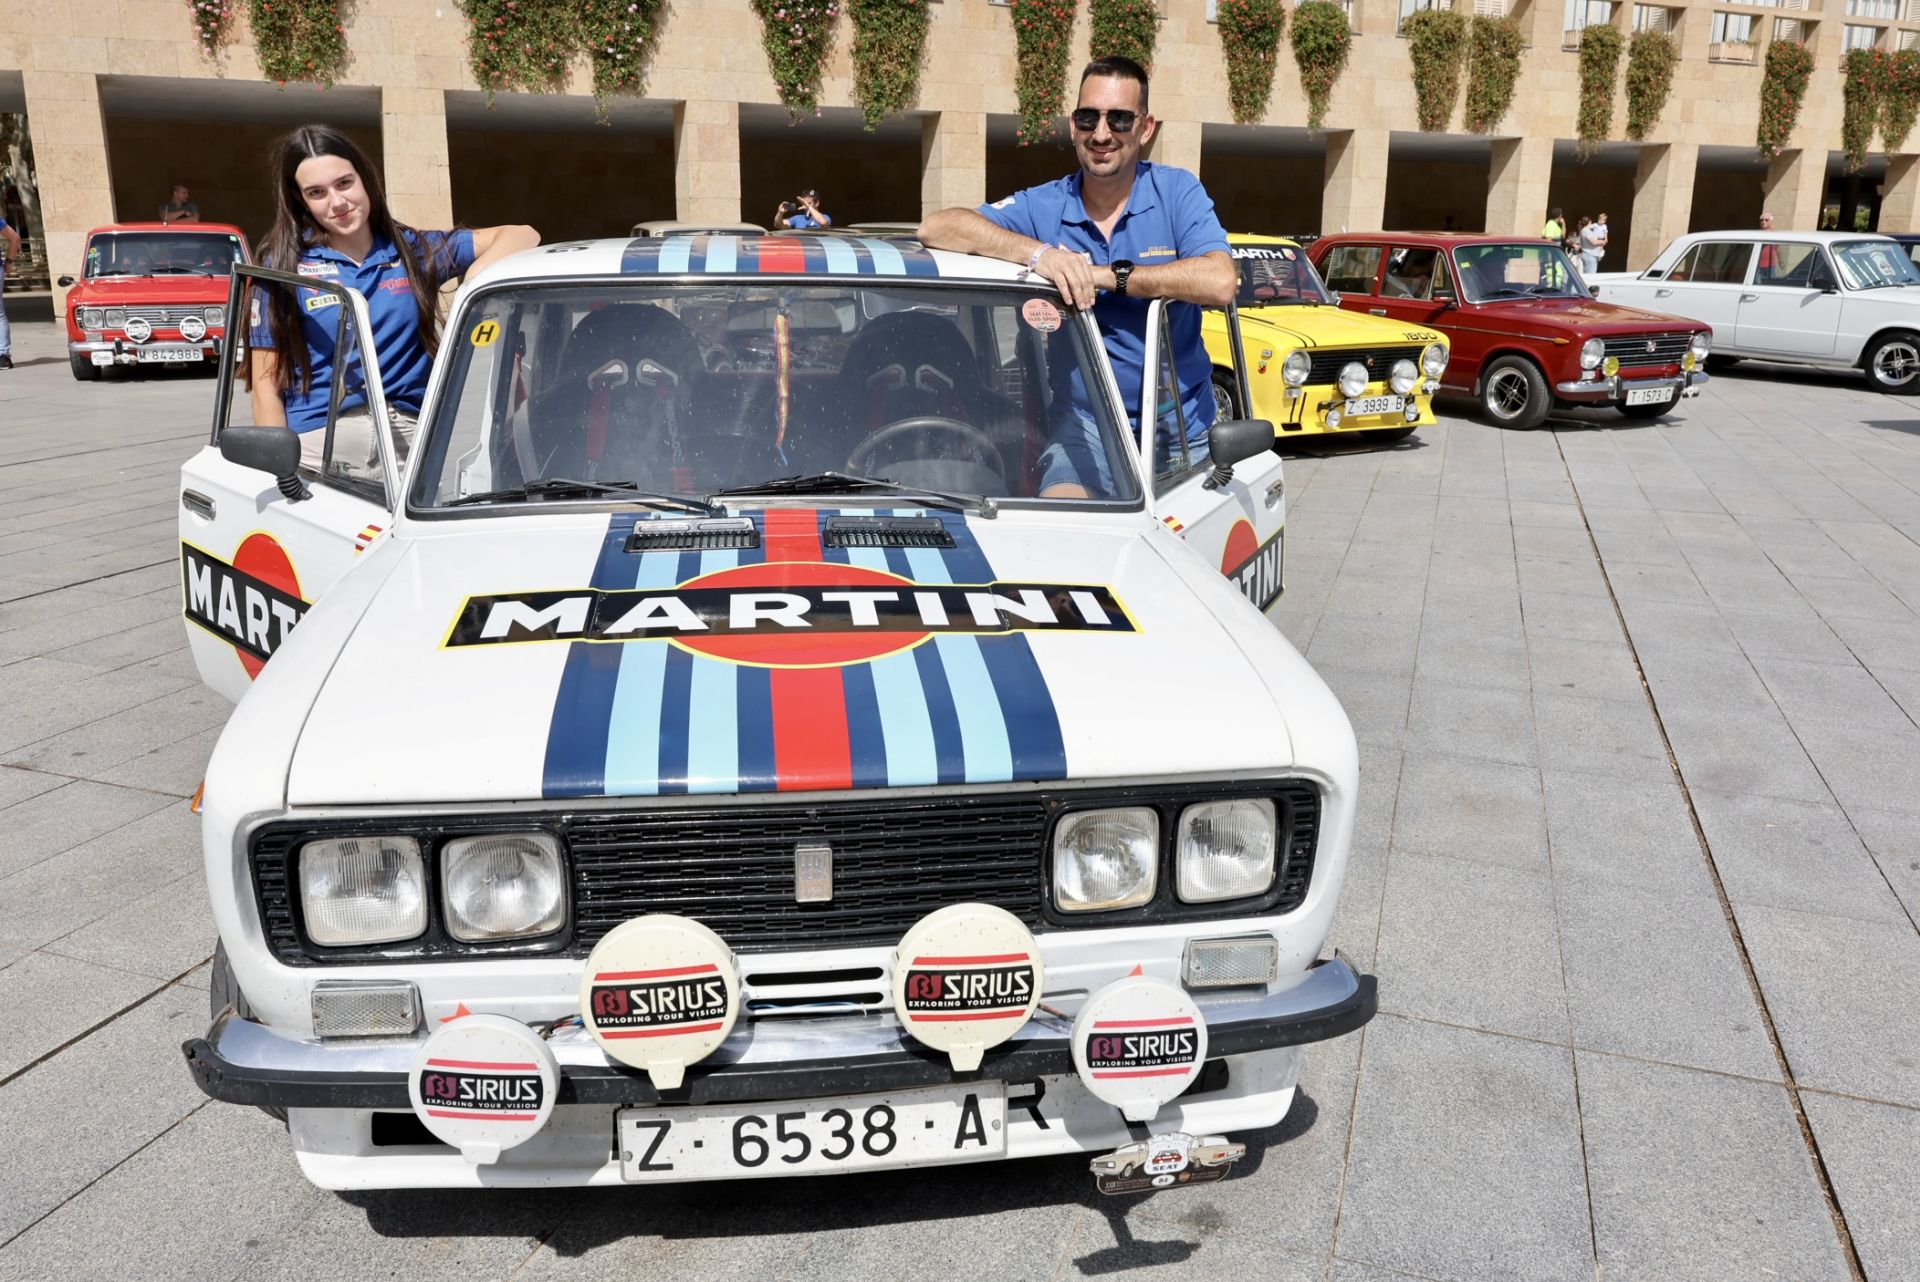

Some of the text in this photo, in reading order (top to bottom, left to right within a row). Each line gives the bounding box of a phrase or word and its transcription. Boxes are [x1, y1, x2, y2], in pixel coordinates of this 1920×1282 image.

[475, 325, 495, 342] H
[152, 349, 200, 360] 842986
[188, 556, 305, 654] MART
[480, 590, 1112, 638] MARTINI
[944, 970, 1030, 999] SIRIUS
[630, 981, 723, 1015] SIRIUS
[997, 995, 1029, 1004] VISION
[597, 1007, 724, 1024] EXPLORING YOUR VISION
[1124, 1032, 1193, 1058] SIRIUS
[460, 1078, 537, 1101] SIRIUS
[426, 1098, 473, 1107] EXPLORING
[1152, 1164, 1179, 1172] SEAT
